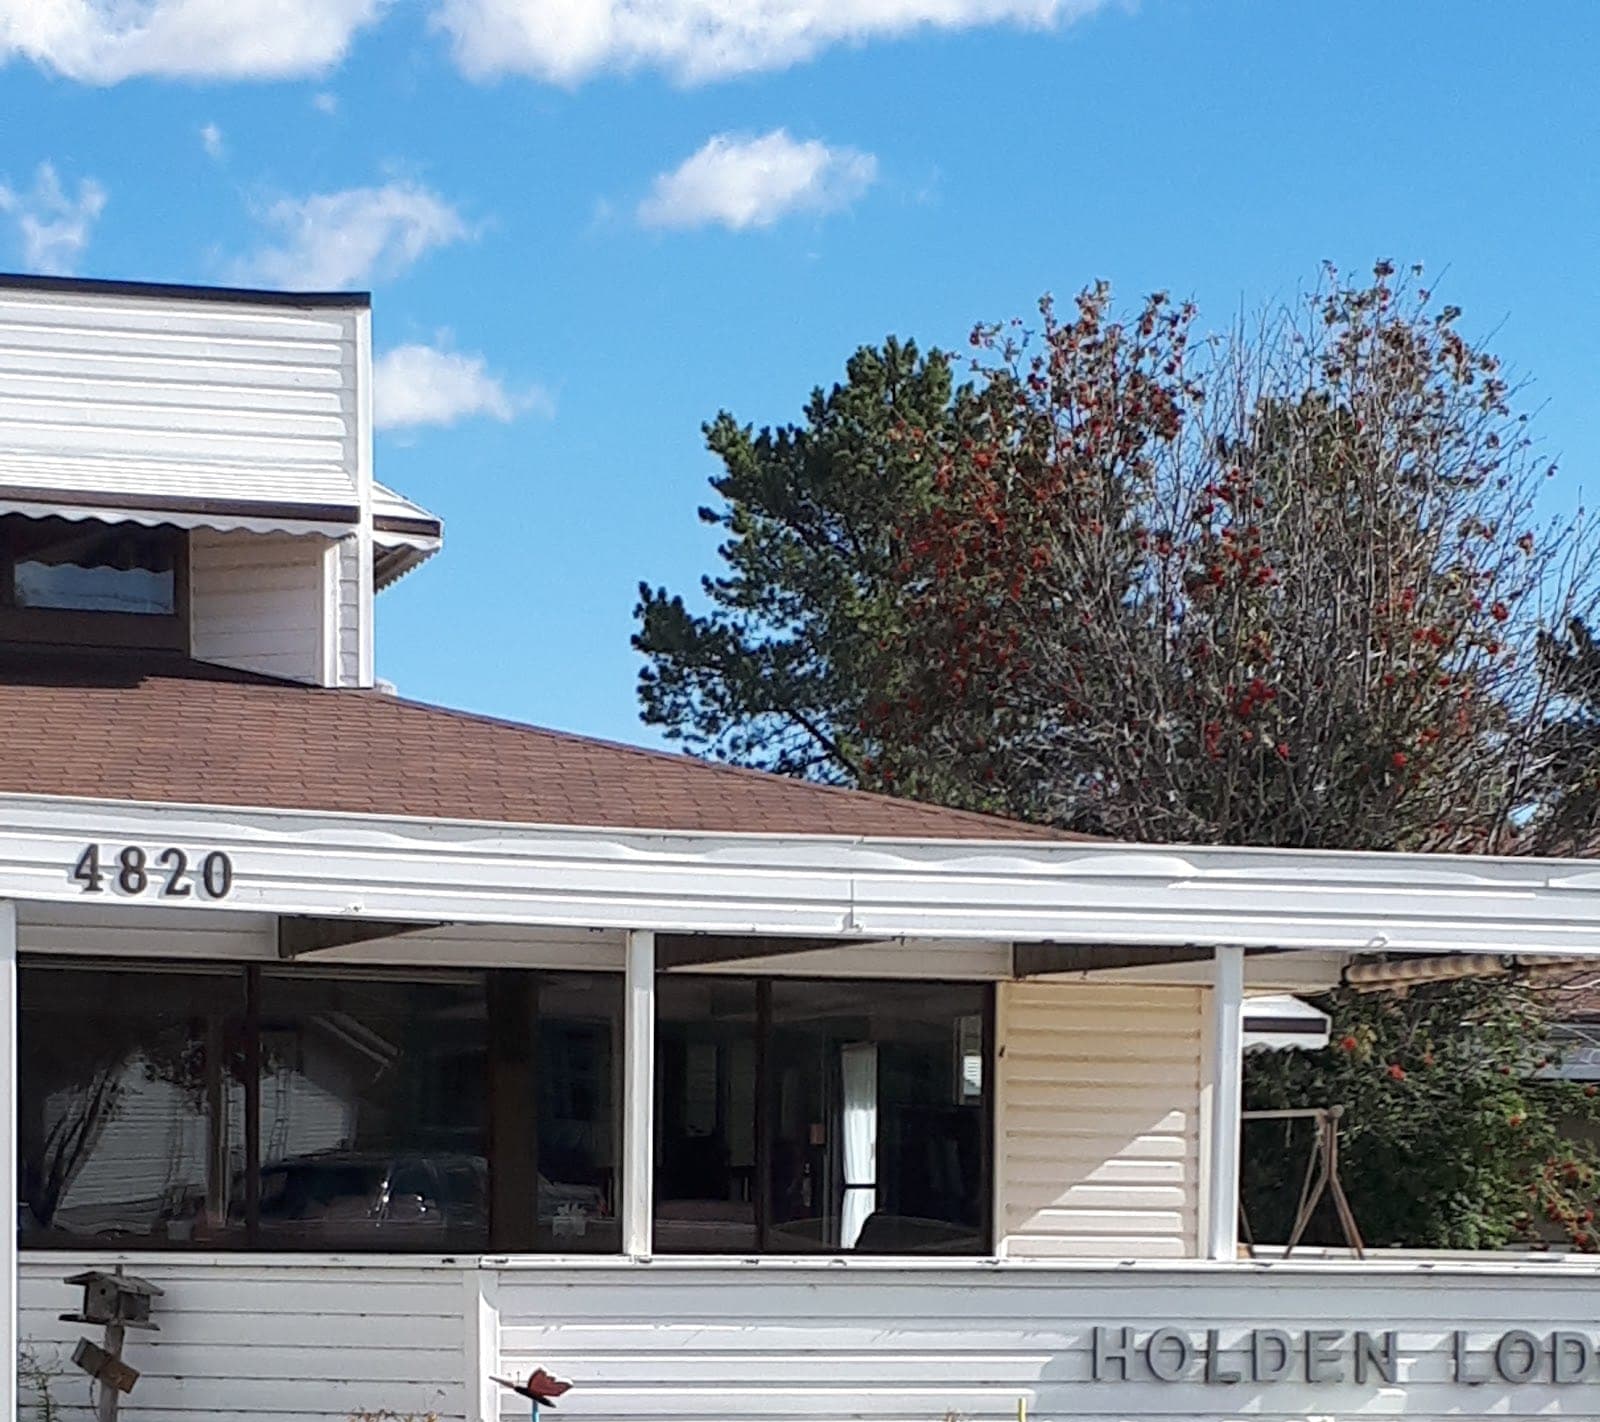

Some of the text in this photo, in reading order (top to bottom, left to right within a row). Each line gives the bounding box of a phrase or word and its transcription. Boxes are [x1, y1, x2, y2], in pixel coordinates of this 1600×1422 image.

[74, 843, 233, 898] 4820
[1091, 1325, 1600, 1386] HOLDEN LOD
